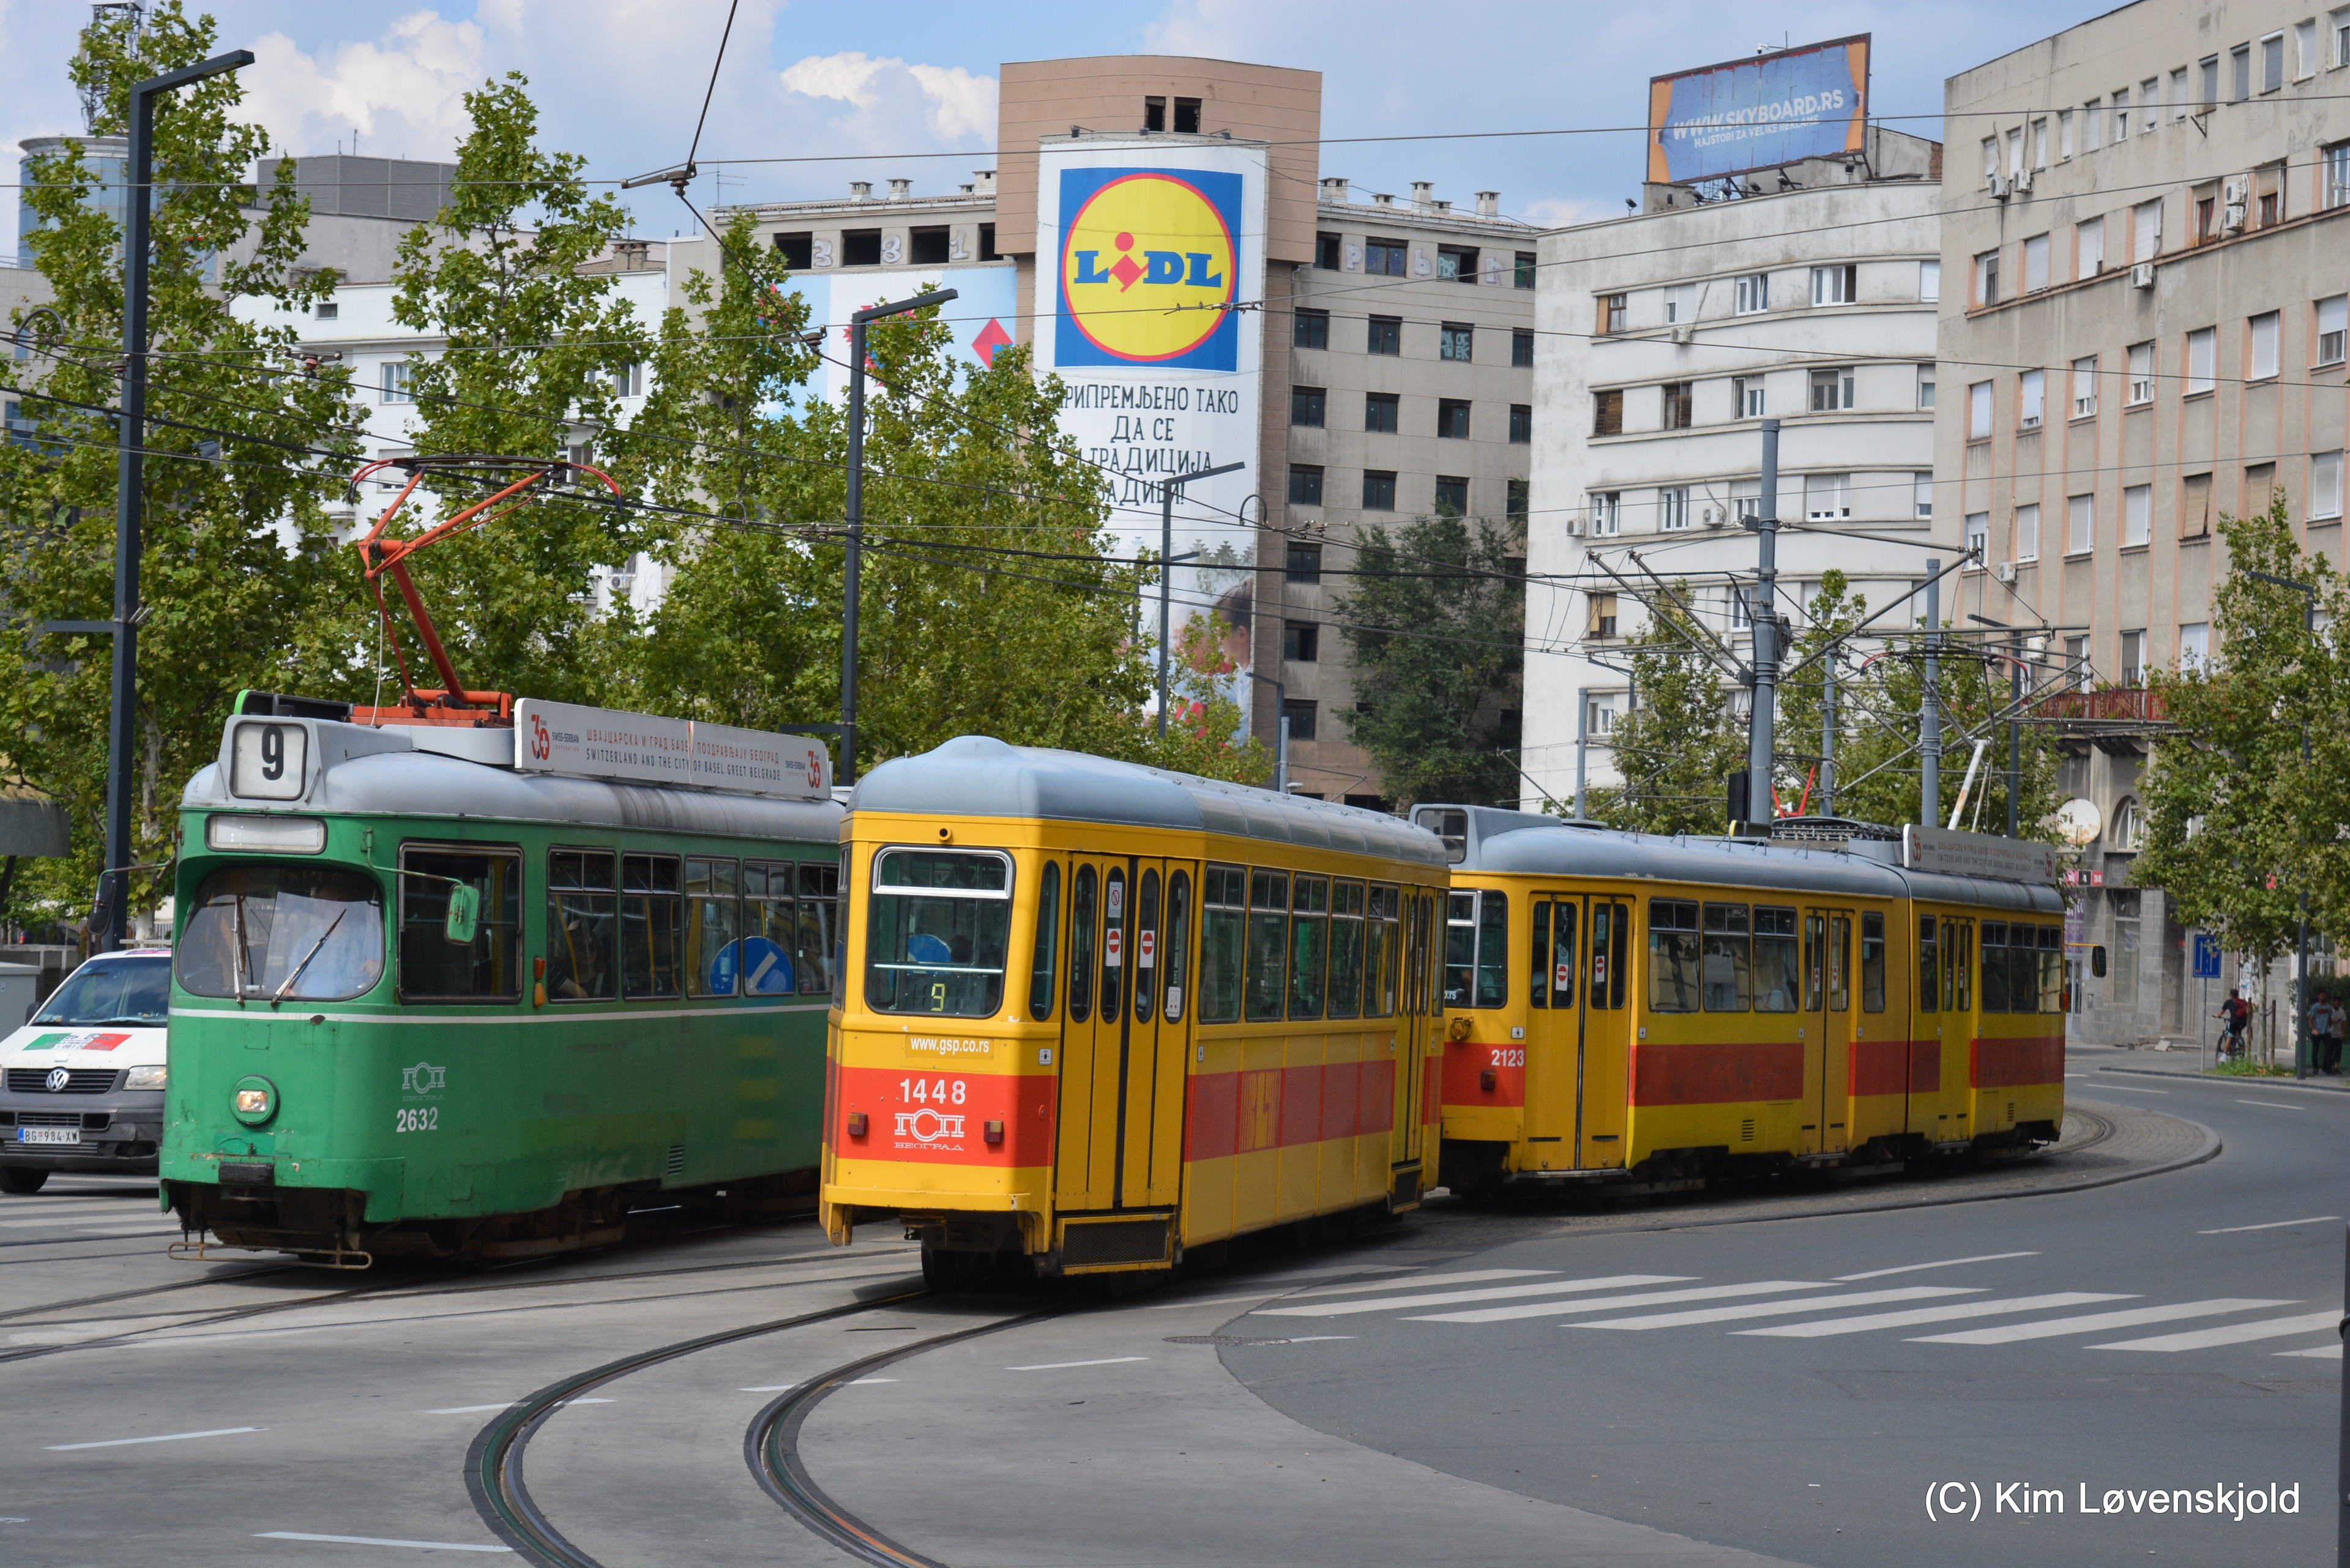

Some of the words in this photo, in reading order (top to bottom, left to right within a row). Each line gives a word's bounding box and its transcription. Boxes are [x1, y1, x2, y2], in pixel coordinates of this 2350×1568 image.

[1673, 89, 1844, 140] WWW.SKYBOARD.RS
[1693, 131, 1734, 148] MAJSTORI
[1736, 128, 1747, 140] ZA
[1748, 123, 1778, 138] VELIKE
[1059, 384, 1188, 411] РИПРЕМЉЕНО
[1196, 388, 1239, 414] ТАКО
[1110, 416, 1145, 443] ДА
[1152, 417, 1175, 441] СЕ
[1090, 447, 1212, 476] ТРАДИЦИЈА
[552, 731, 580, 744] SWISS-SERBIAN
[586, 728, 639, 746] ШВАЈЦАРСКА
[641, 735, 646, 746] И
[650, 736, 668, 752] ГРАД
[697, 742, 747, 760] ПОЗДРАВЉАЈУ
[750, 749, 780, 765] БЕОГРАД
[261, 725, 284, 781] 9
[586, 748, 638, 765] SWITZERLAND
[641, 756, 655, 766] AND
[658, 756, 671, 769] THE
[674, 758, 690, 771] CITY
[693, 760, 701, 772] OF
[704, 761, 725, 775] BASEL
[727, 764, 747, 777] GREET
[749, 767, 781, 781] BELGRADE
[931, 983, 946, 1012] 9
[910, 1037, 990, 1055] www.gsp.co.rs
[1491, 1049, 1524, 1067] 2123
[401, 1062, 446, 1094] ГСП
[900, 1078, 966, 1105] 1448
[396, 1107, 438, 1132] 2632
[894, 1108, 965, 1143] ГСП
[25, 1130, 37, 1143] BG
